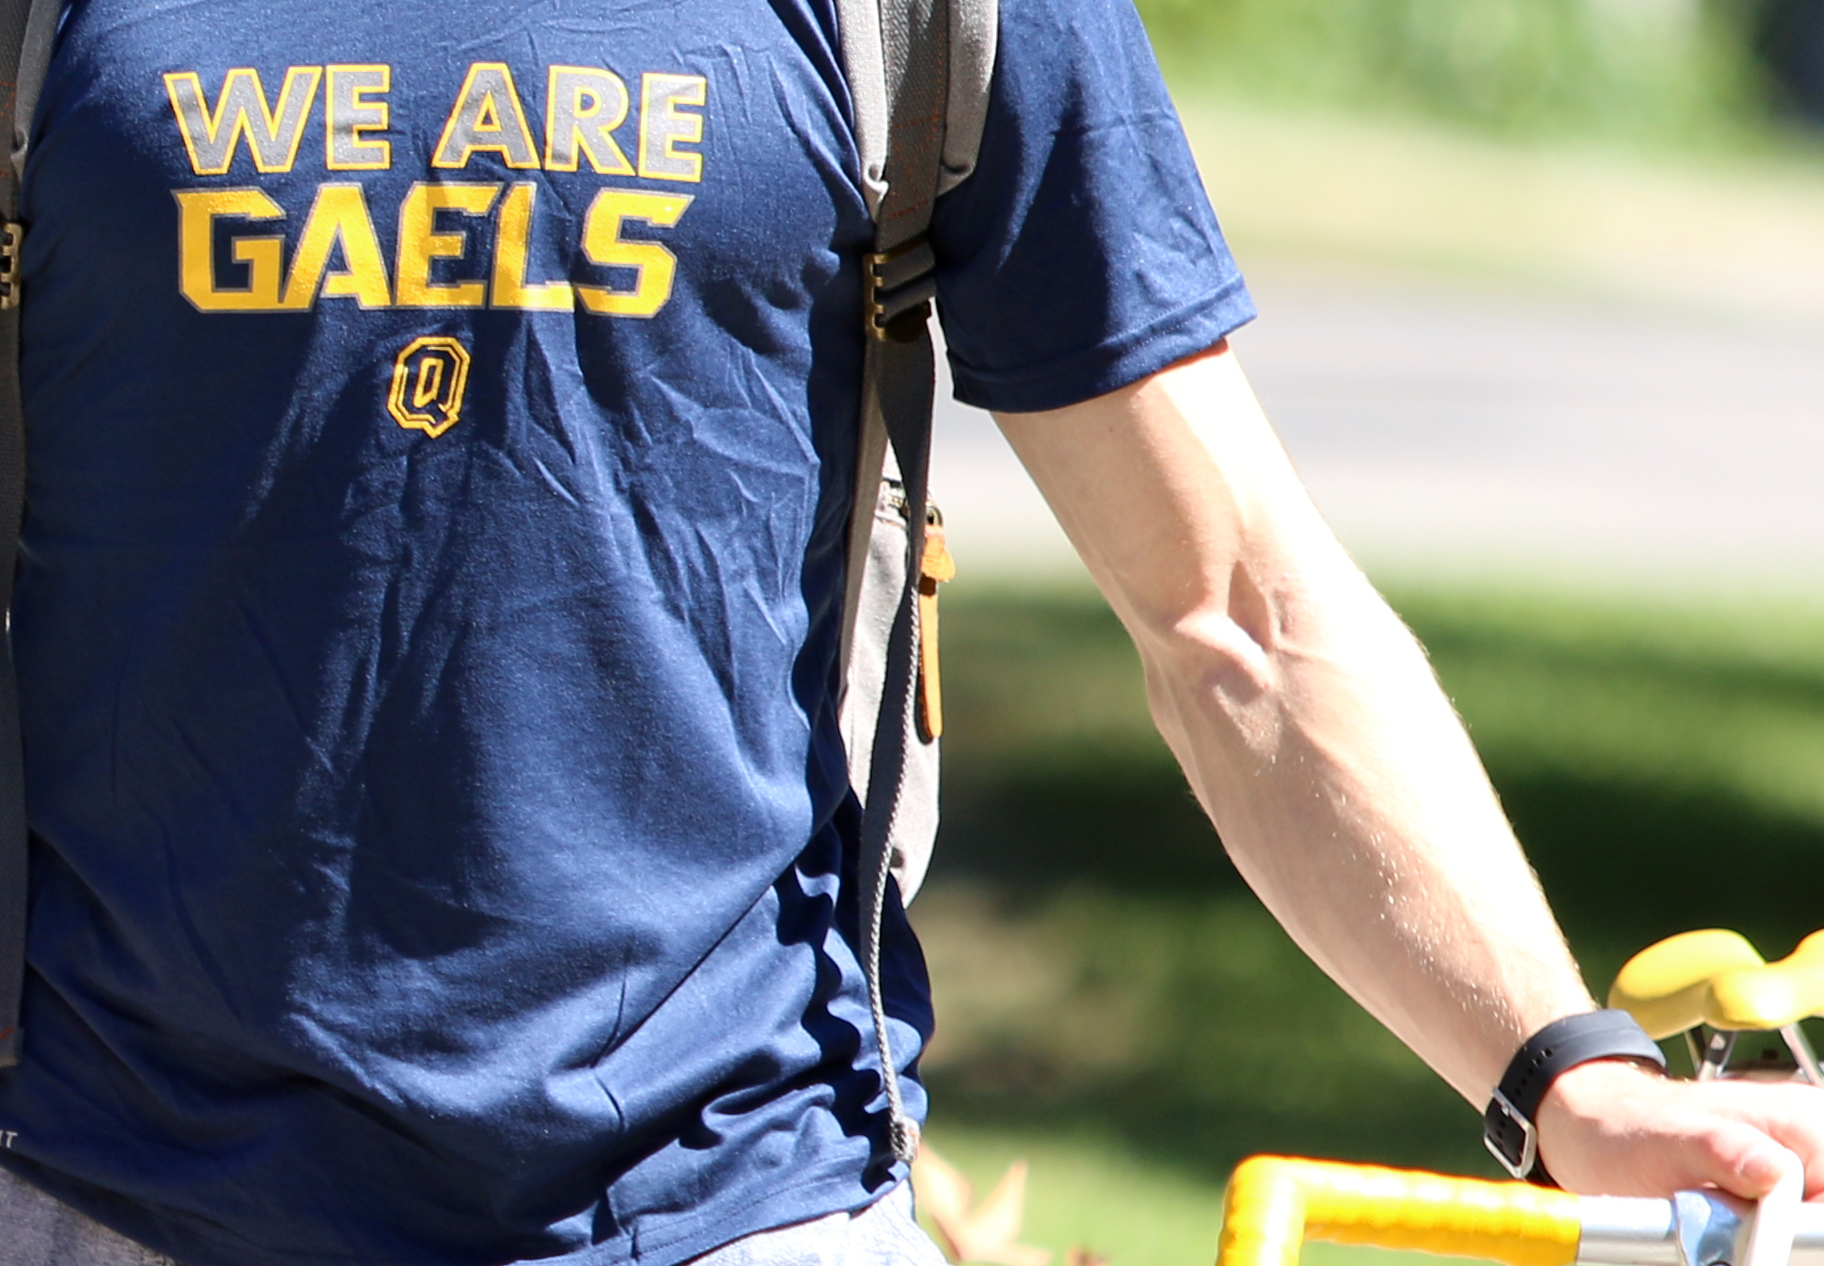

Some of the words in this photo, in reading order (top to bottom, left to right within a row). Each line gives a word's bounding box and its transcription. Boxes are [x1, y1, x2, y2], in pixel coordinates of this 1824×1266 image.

[163, 64, 391, 175] WE
[431, 62, 707, 182] ARE
[171, 181, 695, 319] GAELS
[386, 336, 470, 438] Q
